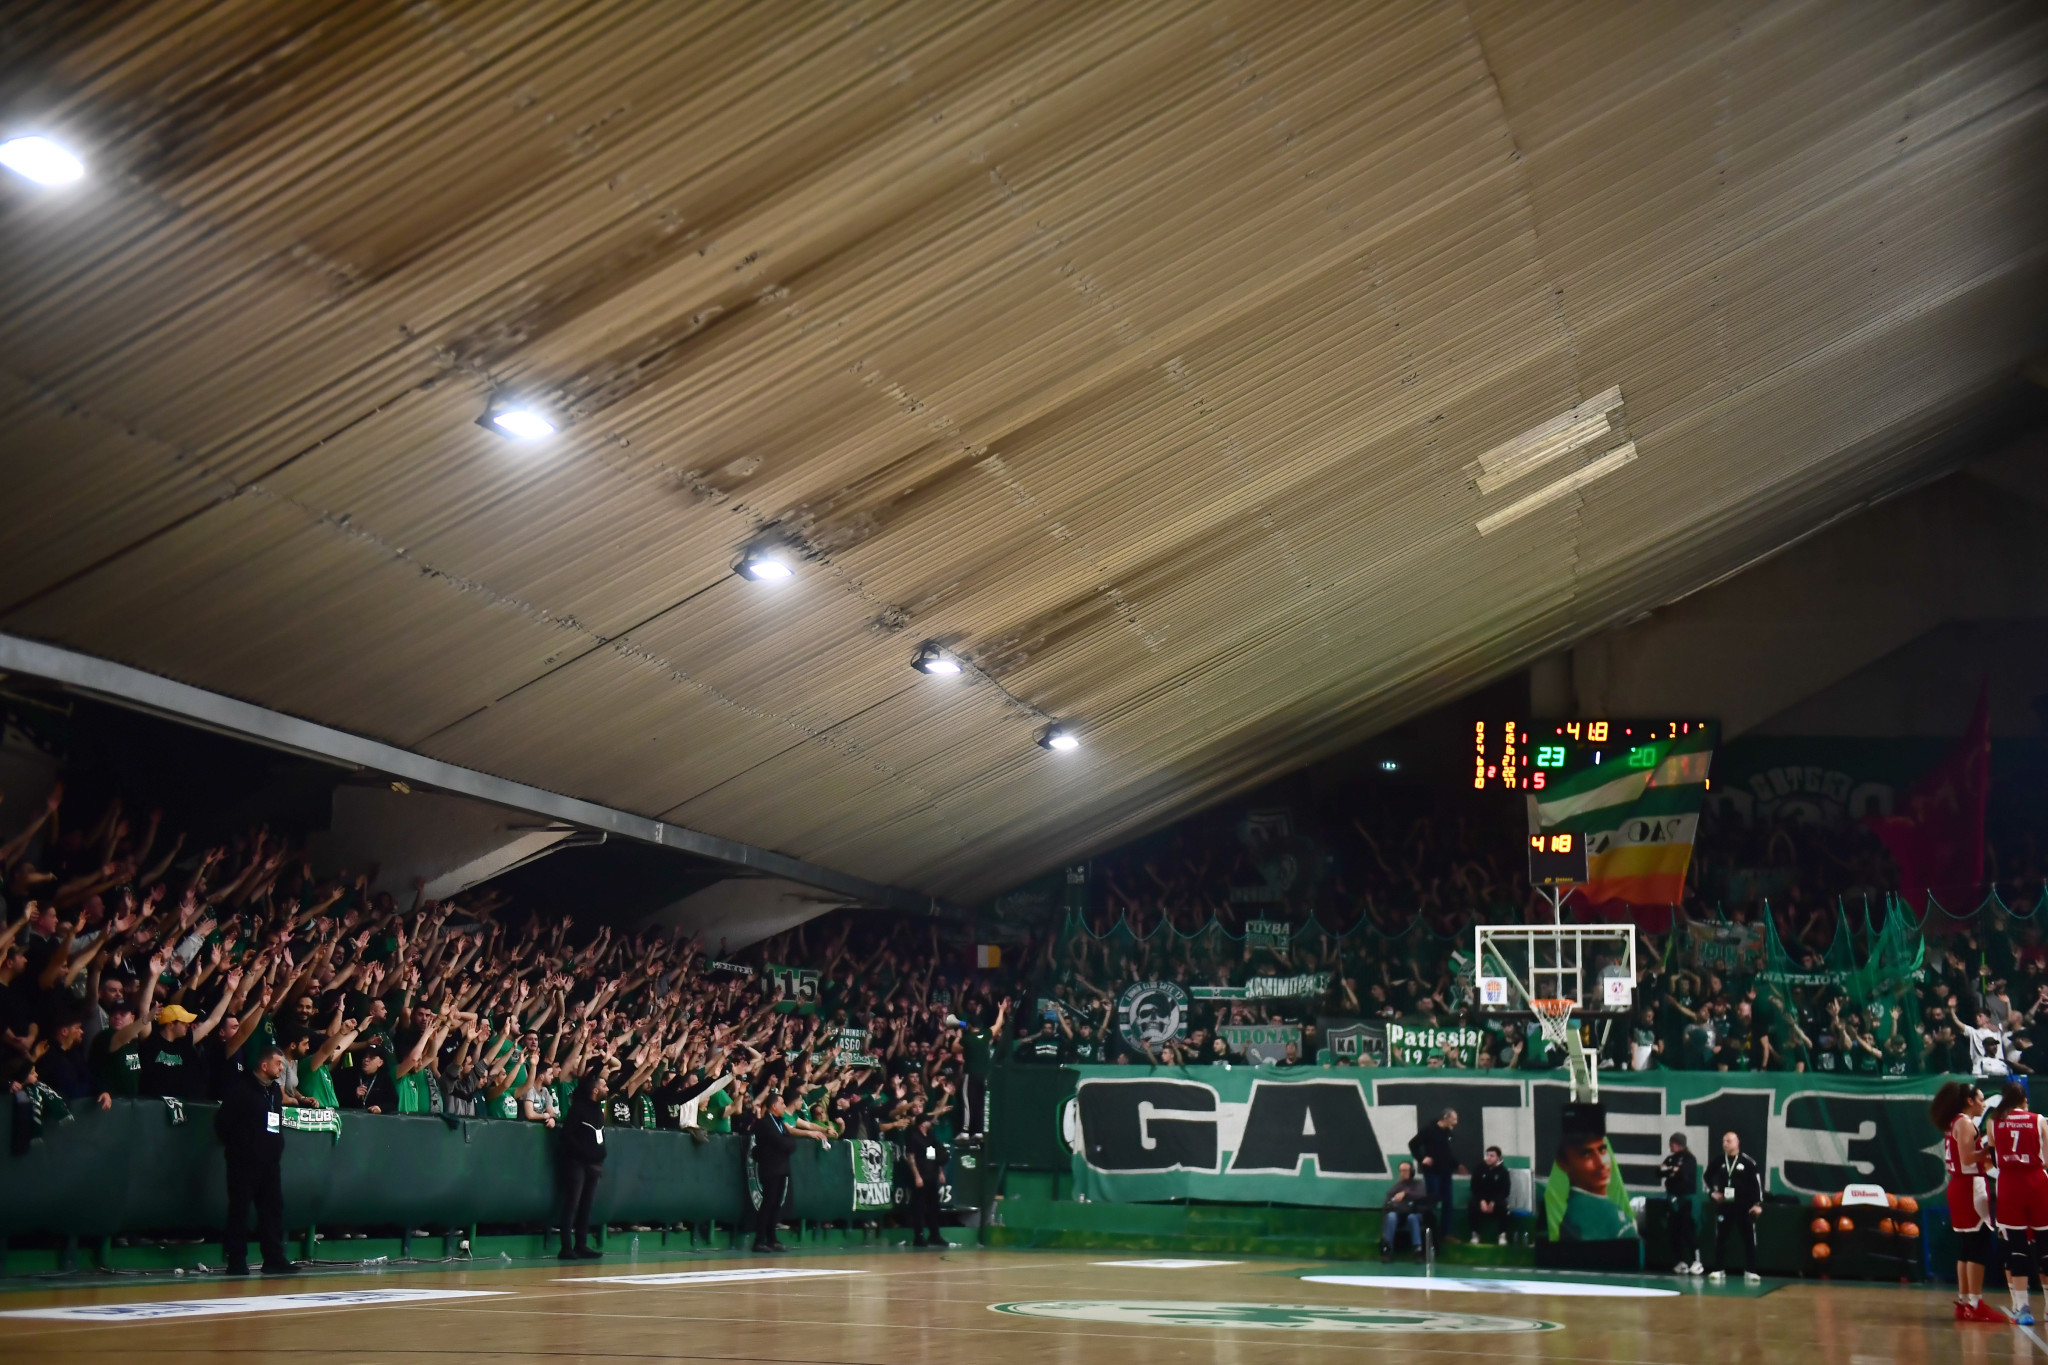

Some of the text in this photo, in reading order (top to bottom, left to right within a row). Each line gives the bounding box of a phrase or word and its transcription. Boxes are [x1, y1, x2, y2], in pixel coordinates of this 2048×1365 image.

[1537, 746, 1566, 767] 23
[1533, 771, 1545, 789] 5
[1391, 1024, 1477, 1048] Patissia
[300, 1109, 332, 1122] CLUB
[2010, 1130, 2020, 1153] 7
[1850, 1189, 1879, 1198] Wilson
